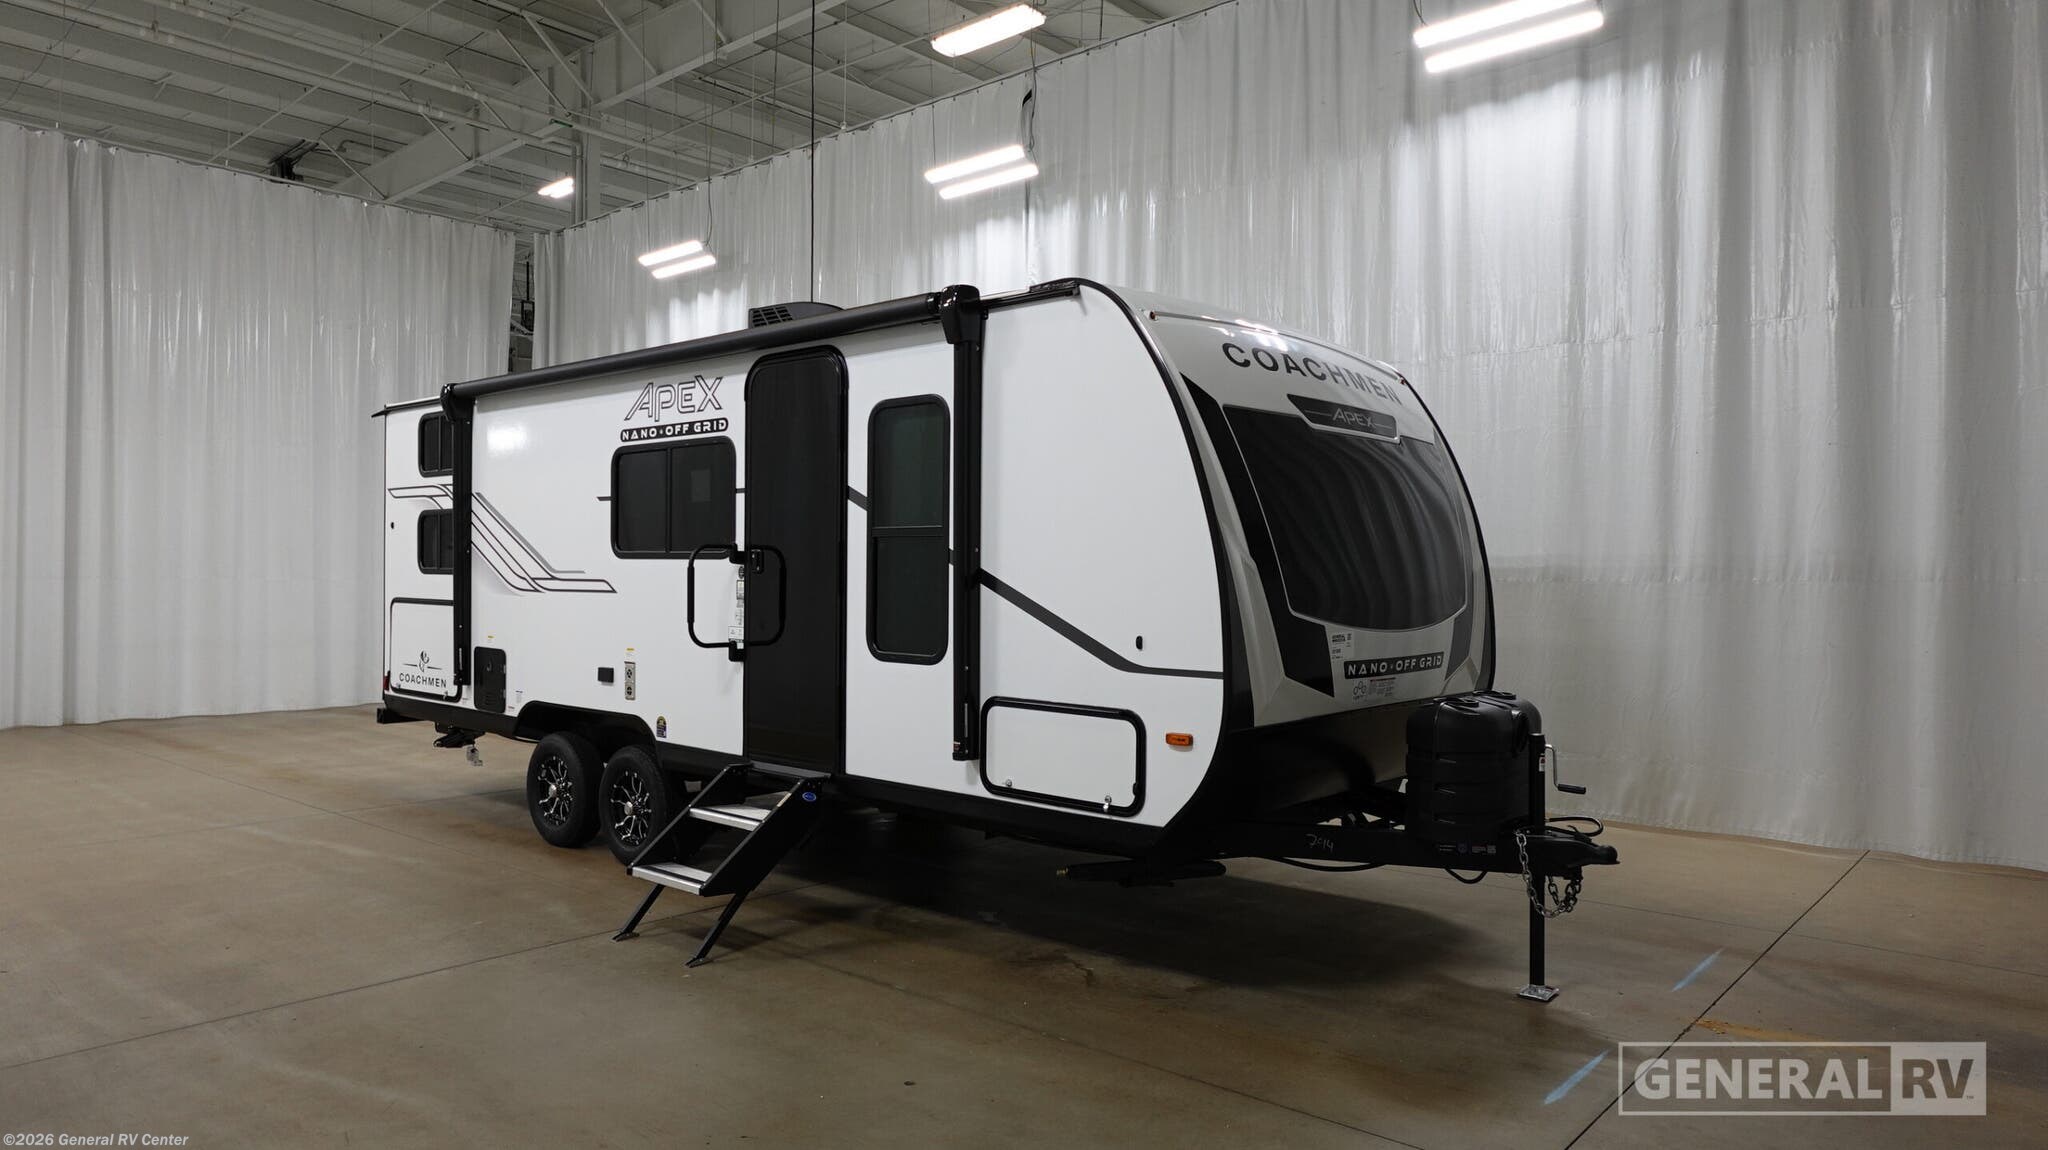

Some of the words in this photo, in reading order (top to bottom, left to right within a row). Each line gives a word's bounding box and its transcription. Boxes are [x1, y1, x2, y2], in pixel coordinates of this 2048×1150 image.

[1222, 342, 1401, 404] COACHMEN
[624, 375, 723, 422] APEX
[693, 419, 727, 432] GRID
[1332, 407, 1376, 428] APEX
[1419, 655, 1443, 668] GRID
[399, 672, 447, 688] COACHMEN
